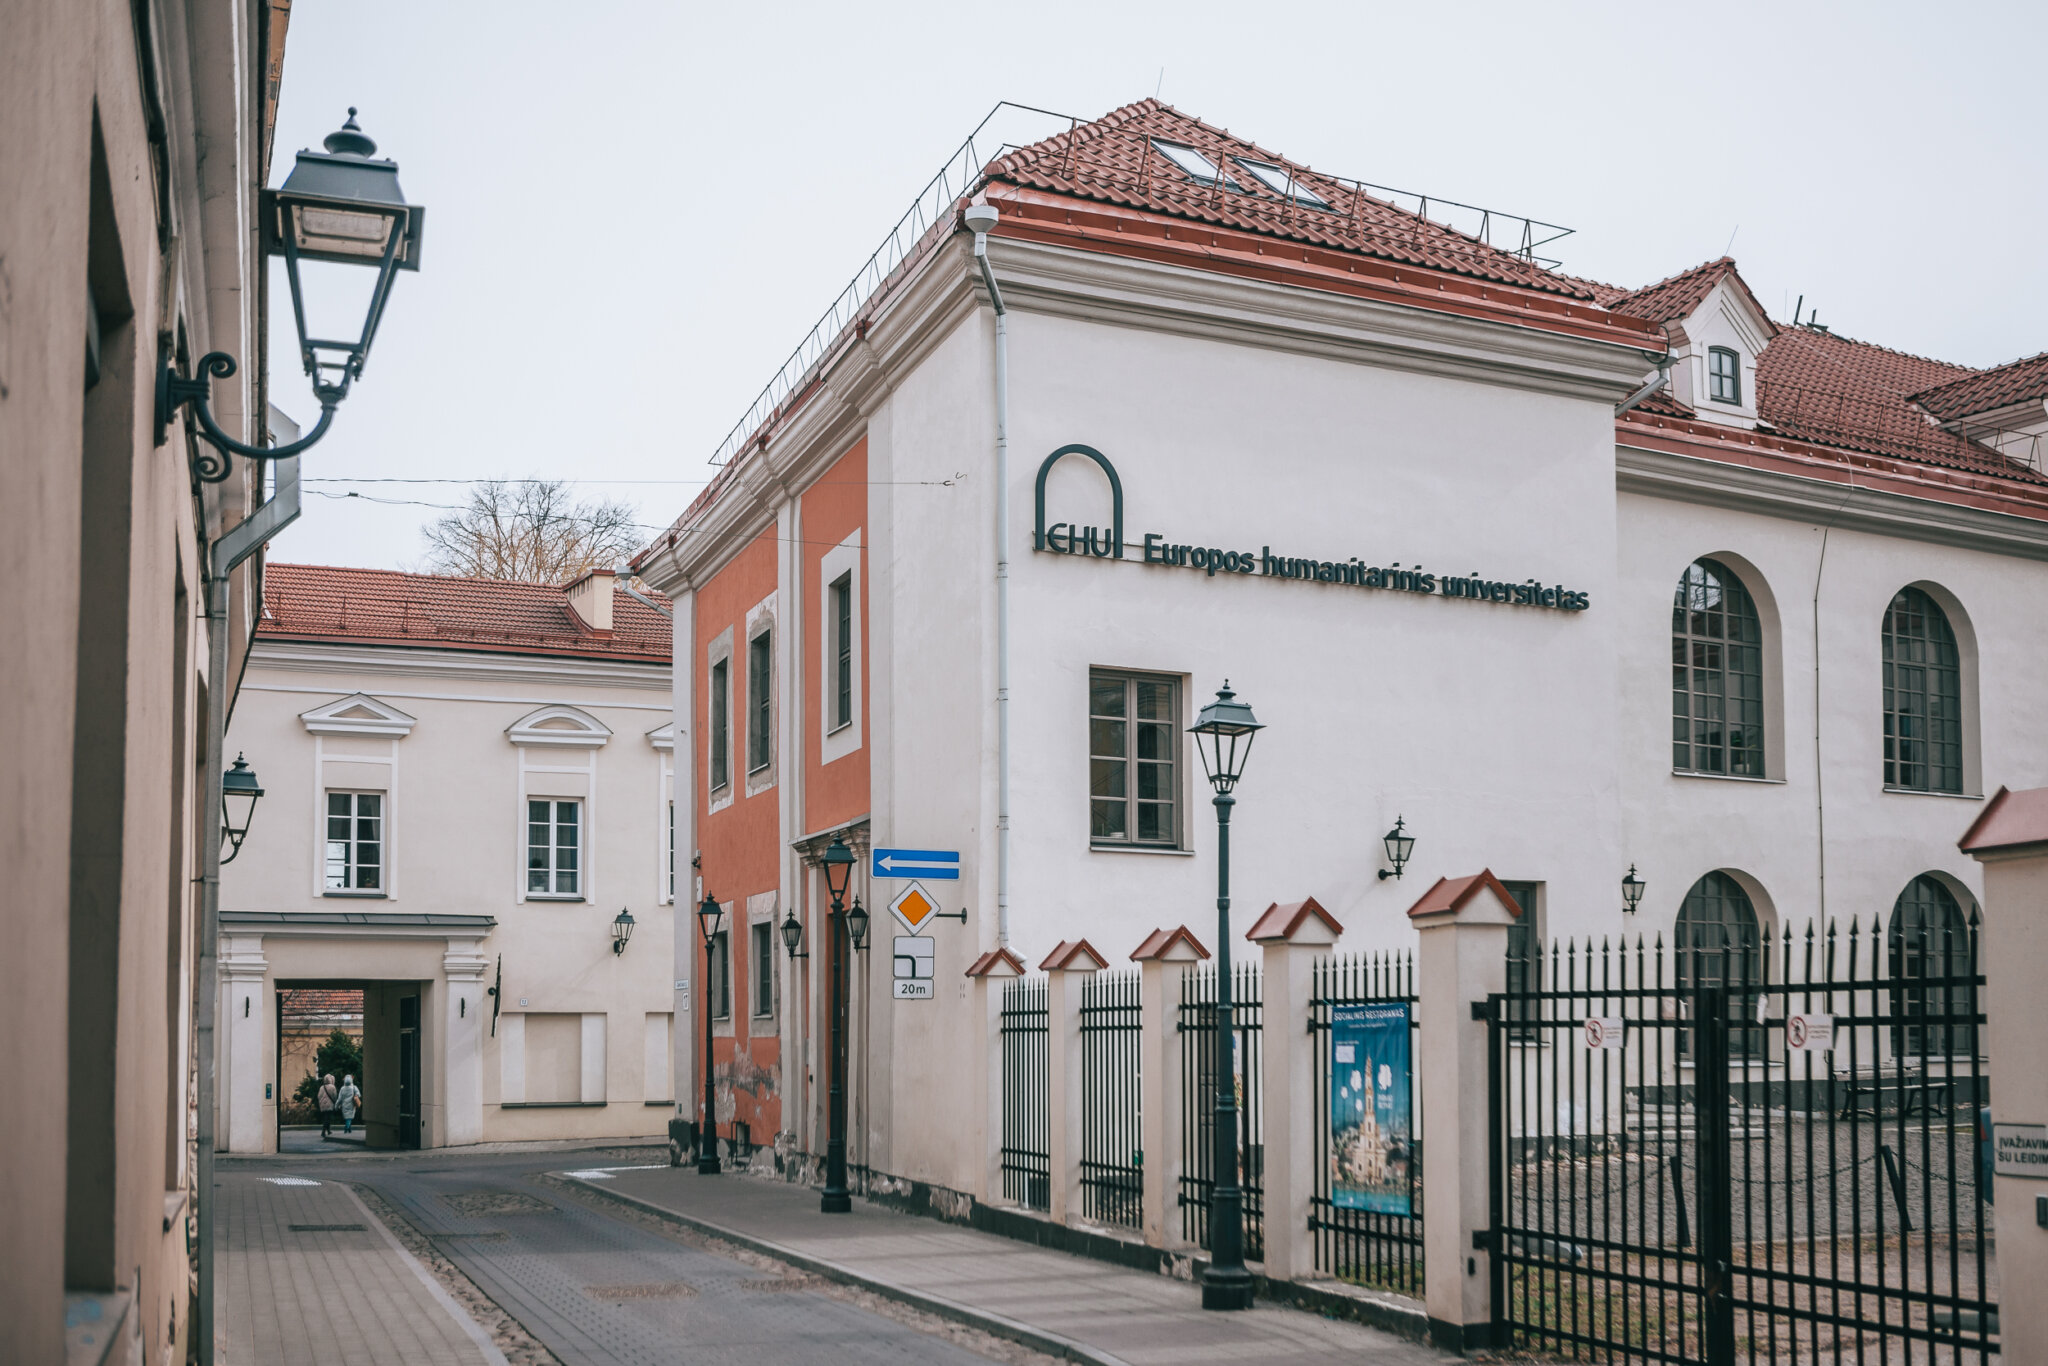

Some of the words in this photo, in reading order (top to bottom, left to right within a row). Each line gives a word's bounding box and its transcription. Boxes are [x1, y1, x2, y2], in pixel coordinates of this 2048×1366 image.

[1047, 522, 1111, 557] EHU
[1144, 533, 1255, 576] Europos
[1262, 546, 1436, 592] humanitarinis
[1442, 572, 1590, 611] universitetas
[1998, 1151, 2012, 1162] SU
